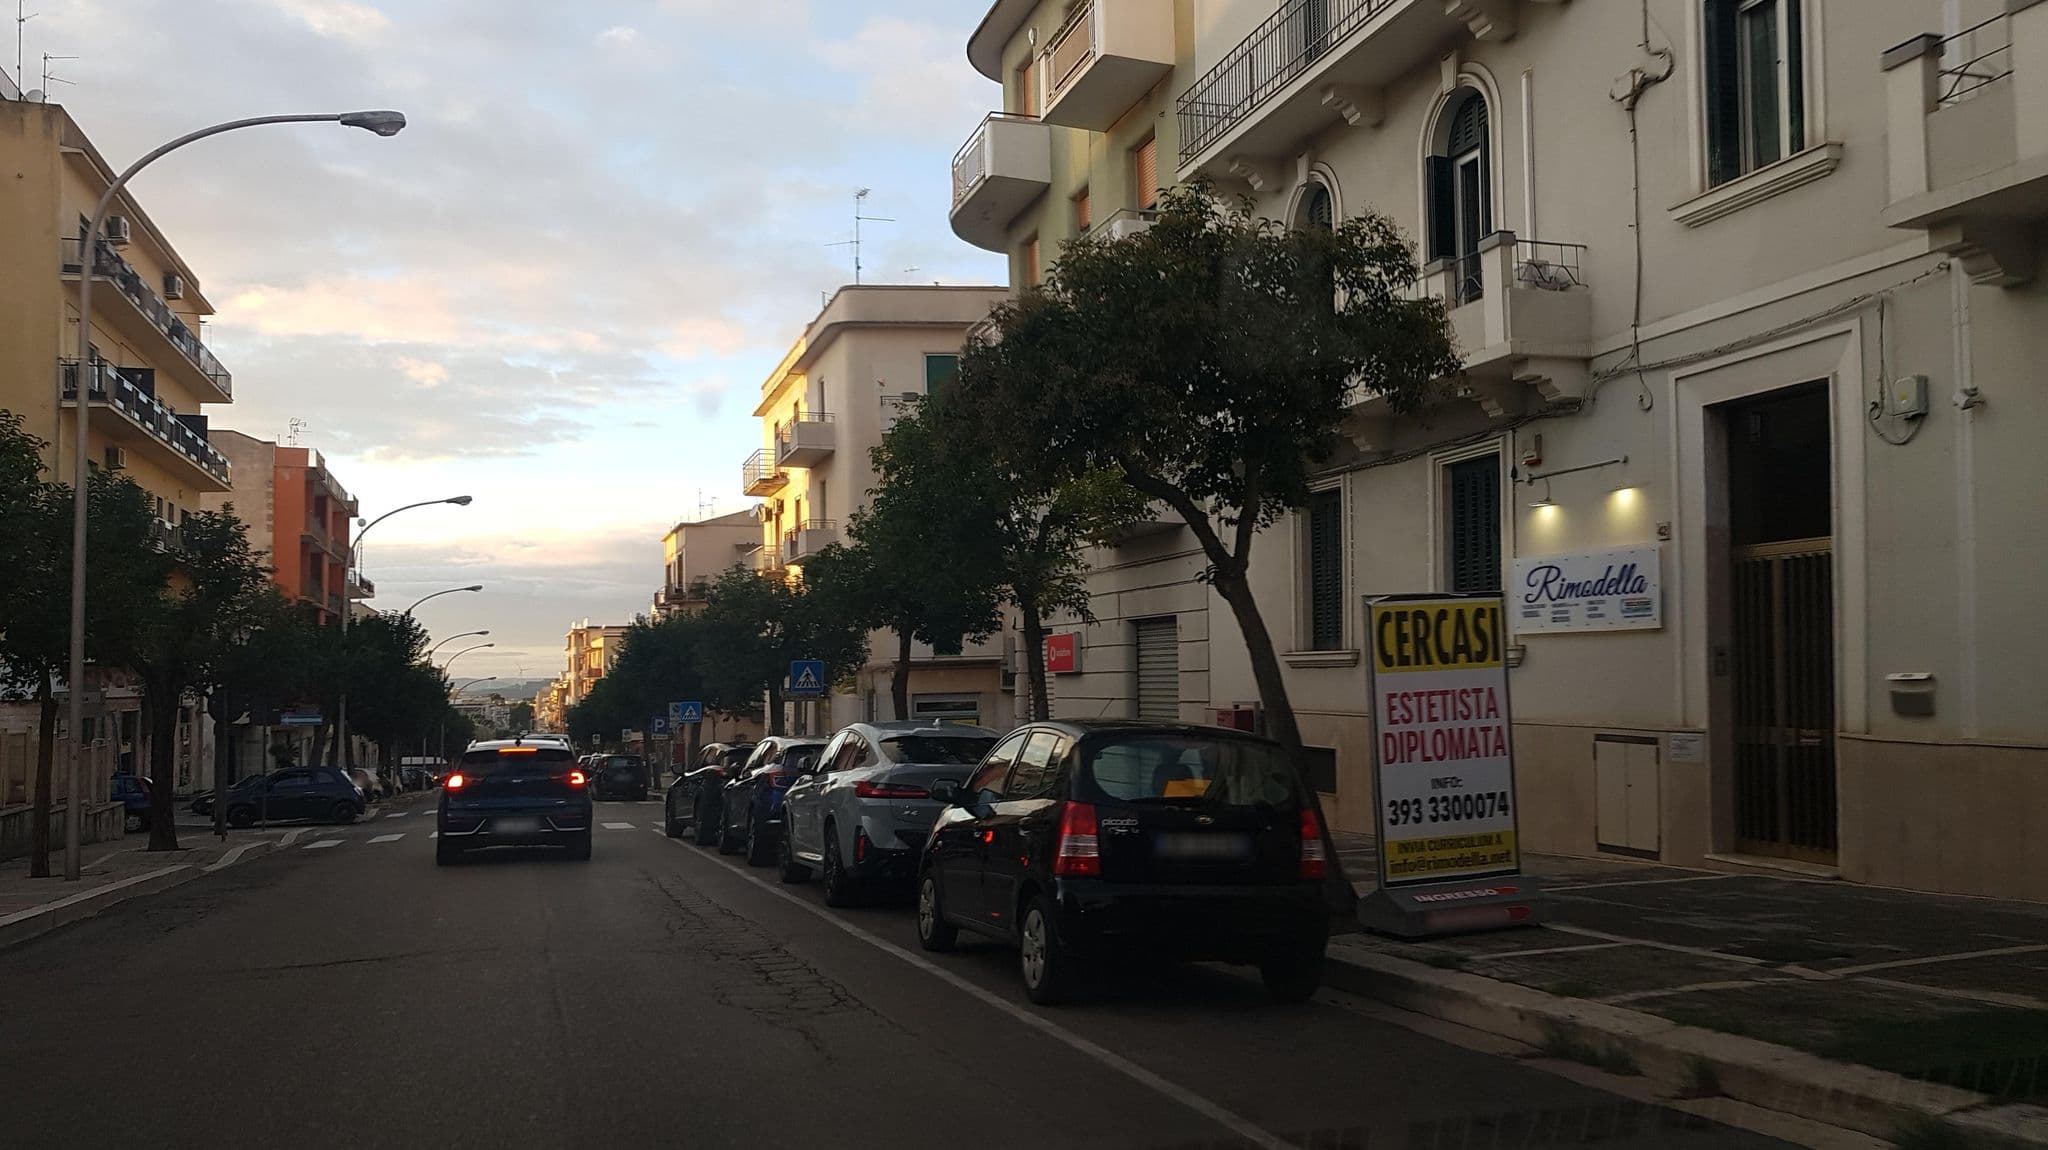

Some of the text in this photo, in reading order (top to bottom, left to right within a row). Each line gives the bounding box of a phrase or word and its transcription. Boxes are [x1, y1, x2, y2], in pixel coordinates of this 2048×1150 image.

[1525, 563, 1648, 603] Rimodella
[1378, 607, 1501, 667] CERCASI
[1387, 687, 1500, 725] ESTETISTA
[1383, 726, 1507, 765] DIPLOMATA
[1431, 776, 1463, 790] INFO:
[1388, 791, 1509, 826] 393 3300074
[1390, 850, 1513, 874] info@rimodella.net
[1398, 841, 1426, 854] INVIA
[1429, 836, 1492, 851] CURRICULUM
[1412, 888, 1497, 903] INGRESSO
